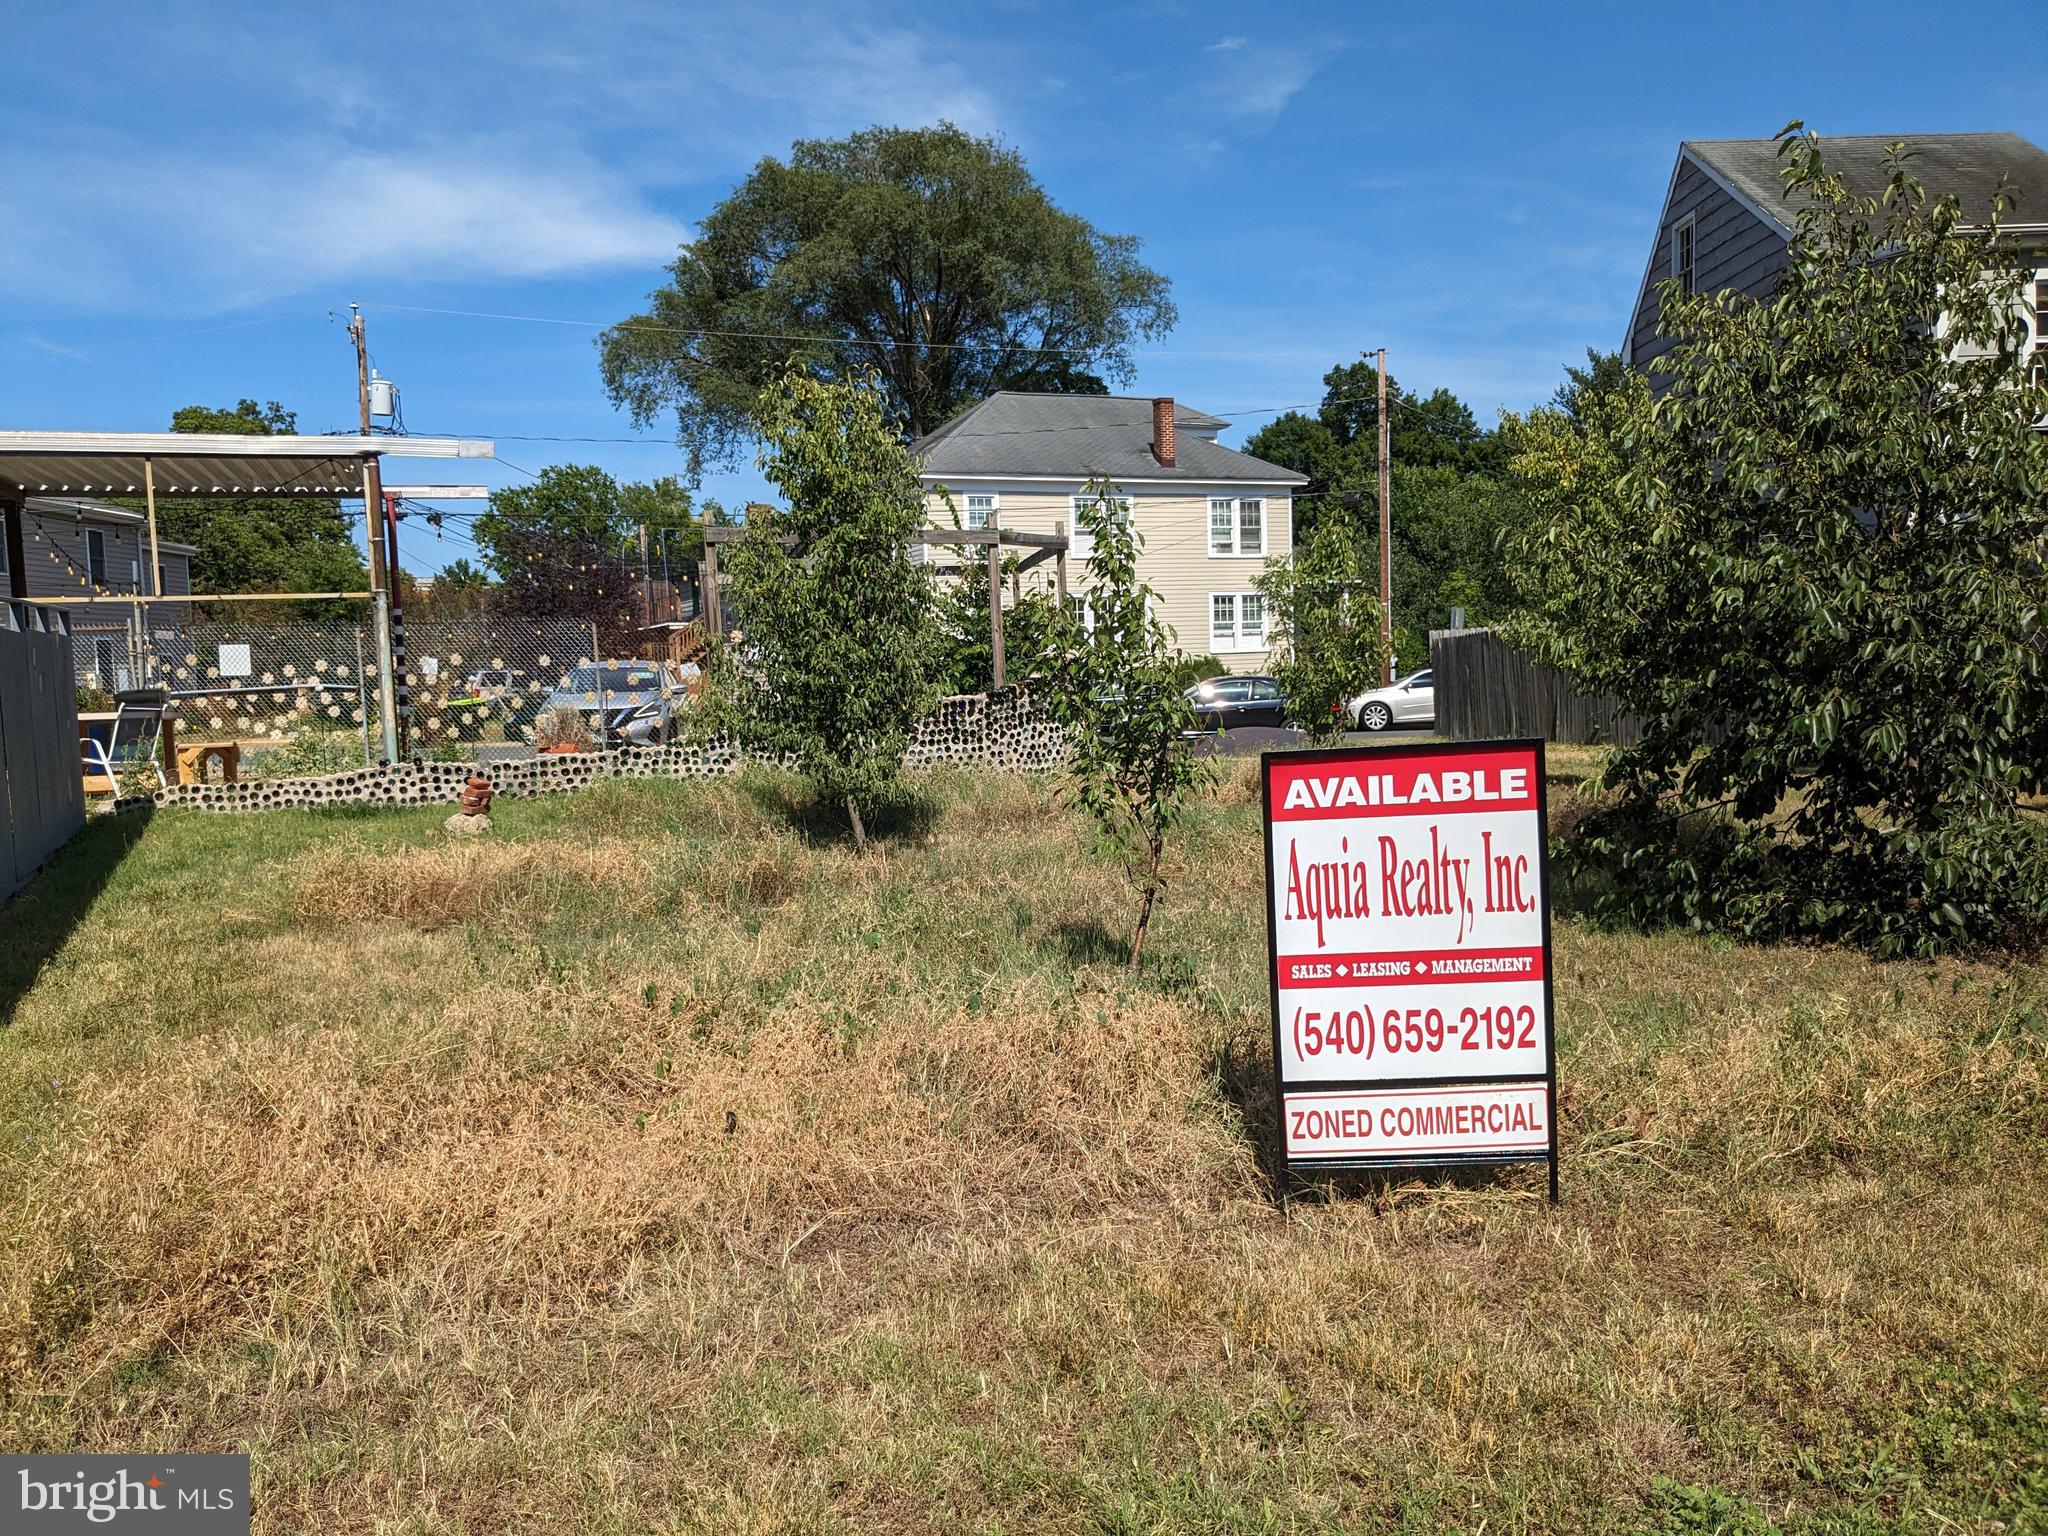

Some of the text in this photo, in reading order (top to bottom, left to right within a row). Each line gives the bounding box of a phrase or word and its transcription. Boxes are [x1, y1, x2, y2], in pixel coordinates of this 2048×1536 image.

[1283, 768, 1529, 810] AVAILABLE
[1284, 824, 1535, 948] Aquia Realty, Inc.
[1291, 957, 1533, 979] SALES LEASING MANAGEMENT
[1293, 1004, 1536, 1062] (540) 659-2192
[1291, 1103, 1543, 1140] ZONED COMMERCIAL
